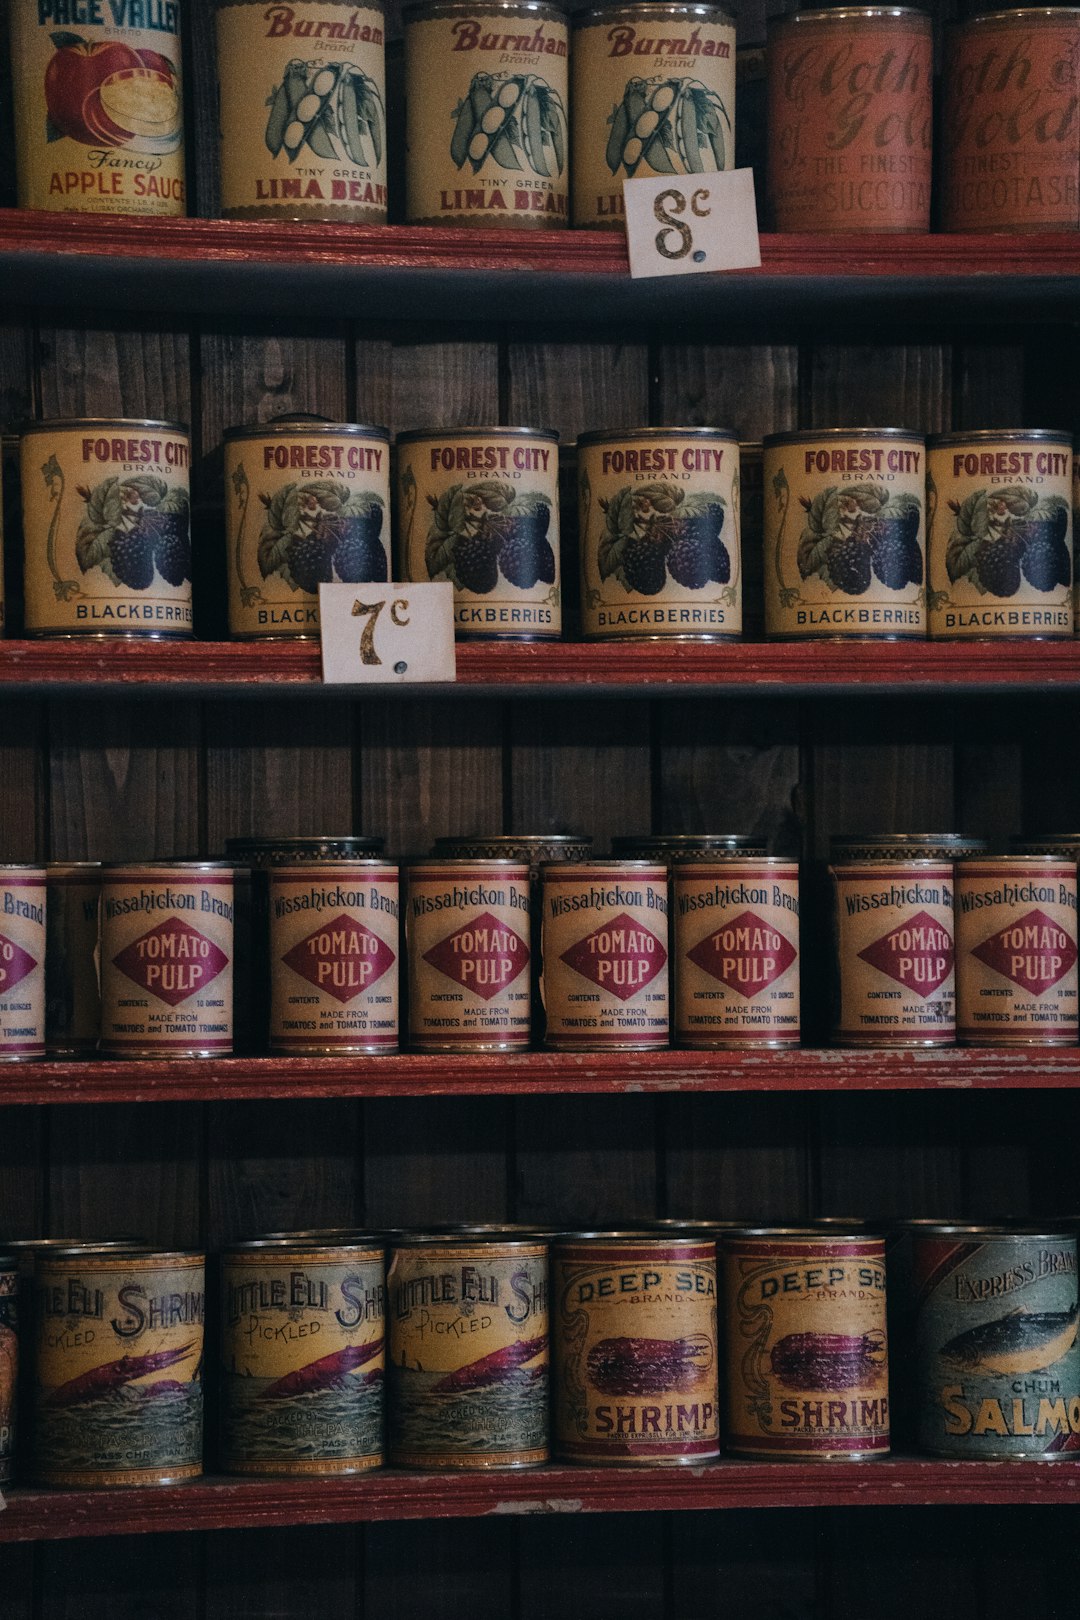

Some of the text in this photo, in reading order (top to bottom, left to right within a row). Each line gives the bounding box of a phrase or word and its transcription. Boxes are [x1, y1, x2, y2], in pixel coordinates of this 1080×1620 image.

[264, 6, 383, 47] Burnham
[313, 40, 356, 53] Brand
[452, 20, 568, 59] Burnham
[607, 26, 731, 59] Burnham
[499, 52, 541, 66] Brand
[653, 56, 696, 69] Brand
[88, 150, 162, 173] Fancy
[813, 155, 915, 176] THE FINEST
[49, 172, 124, 195] APPLE
[296, 168, 372, 180] TINY GREEN
[480, 179, 554, 190] TINY GREEN
[255, 179, 325, 200] LIMA
[440, 189, 508, 210] LIMA
[596, 194, 625, 216] LI
[82, 438, 162, 464] FOREST
[263, 446, 383, 474] FOREST CITY
[431, 447, 550, 473] FOREST CITY
[602, 449, 724, 474] FOREST CITY
[804, 449, 920, 475] FOREST CITY
[123, 463, 172, 475] BRAND
[301, 469, 357, 479] BRAND
[467, 470, 522, 479] BRAND
[635, 472, 691, 481] BRAND
[953, 452, 1033, 477] FOREST
[1036, 452, 1069, 477] CITY
[842, 473, 895, 482] BRAND
[991, 475, 1044, 484] BRAND
[452, 608, 552, 624] CKBERRIES
[598, 609, 725, 625] BLACKBERRIES
[797, 608, 920, 625] BLACKBERRIES
[945, 612, 1069, 628] BLACKBERRIES
[4, 892, 44, 926] Brand
[106, 888, 195, 920] Wissahickon
[274, 886, 365, 919] Wissahickon
[412, 885, 505, 917] Wissahickon
[550, 886, 642, 919] Wissahickon
[678, 883, 767, 915] Wissahickon
[845, 883, 939, 916] Wissahickon
[960, 882, 1055, 913] Wissahickon
[136, 934, 209, 958] TOMATO
[308, 930, 378, 955] TOMATO
[450, 928, 517, 954] TOMATO
[587, 930, 655, 954] TOMATO
[711, 927, 781, 951] TOMATO
[887, 927, 950, 951] TOMATO
[1000, 925, 1067, 949] TOMATO
[146, 964, 203, 991] PULP
[317, 961, 373, 987] PULP
[461, 959, 513, 984] PULP
[598, 960, 650, 985] PULP
[721, 957, 776, 983] PULP
[899, 957, 946, 982] PULP
[1011, 955, 1062, 980] PULP
[148, 1014, 173, 1022] MADE
[320, 1010, 368, 1018] MADE FROM
[464, 1008, 487, 1016] MADE
[601, 1008, 647, 1016] MADE FROM
[972, 1012, 1010, 1021] TOMATOES
[1013, 1013, 1027, 1021] and
[1030, 1013, 1058, 1021] TOMATO
[1014, 1003, 1060, 1011] MADE FROM
[112, 1024, 145, 1033] TOMATOES
[147, 1025, 162, 1033] and
[165, 1024, 197, 1032] TOMATO
[282, 1021, 317, 1030] TOMATOES
[319, 1021, 334, 1029] and
[336, 1021, 367, 1029] TOMATO
[423, 1018, 460, 1027] TOMATOES
[463, 1018, 477, 1026] and
[480, 1018, 508, 1026] TOMATO
[561, 1018, 597, 1027] TOMATOES
[600, 1018, 614, 1027] and
[617, 1018, 646, 1026] TOMATO
[687, 1015, 722, 1024] TOMATOES
[724, 1016, 739, 1024] and
[741, 1015, 771, 1024] TOMATO
[859, 1015, 899, 1024] TOMATOES
[901, 1016, 916, 1024] and
[918, 1015, 943, 1023] TOMATO
[289, 1271, 327, 1311] ELI
[396, 1266, 498, 1321] LITTLE ELI
[577, 1272, 715, 1304] DEEP SEA
[761, 1268, 844, 1299] DEEP
[816, 1289, 865, 1299] BRAND
[631, 1293, 684, 1304] BRAND
[244, 1314, 321, 1347] PICKLED
[414, 1309, 492, 1341] PICKLED
[1011, 1380, 1060, 1393] CHUM
[595, 1402, 712, 1433] SHRIMP
[780, 1398, 888, 1427] SHRIMP
